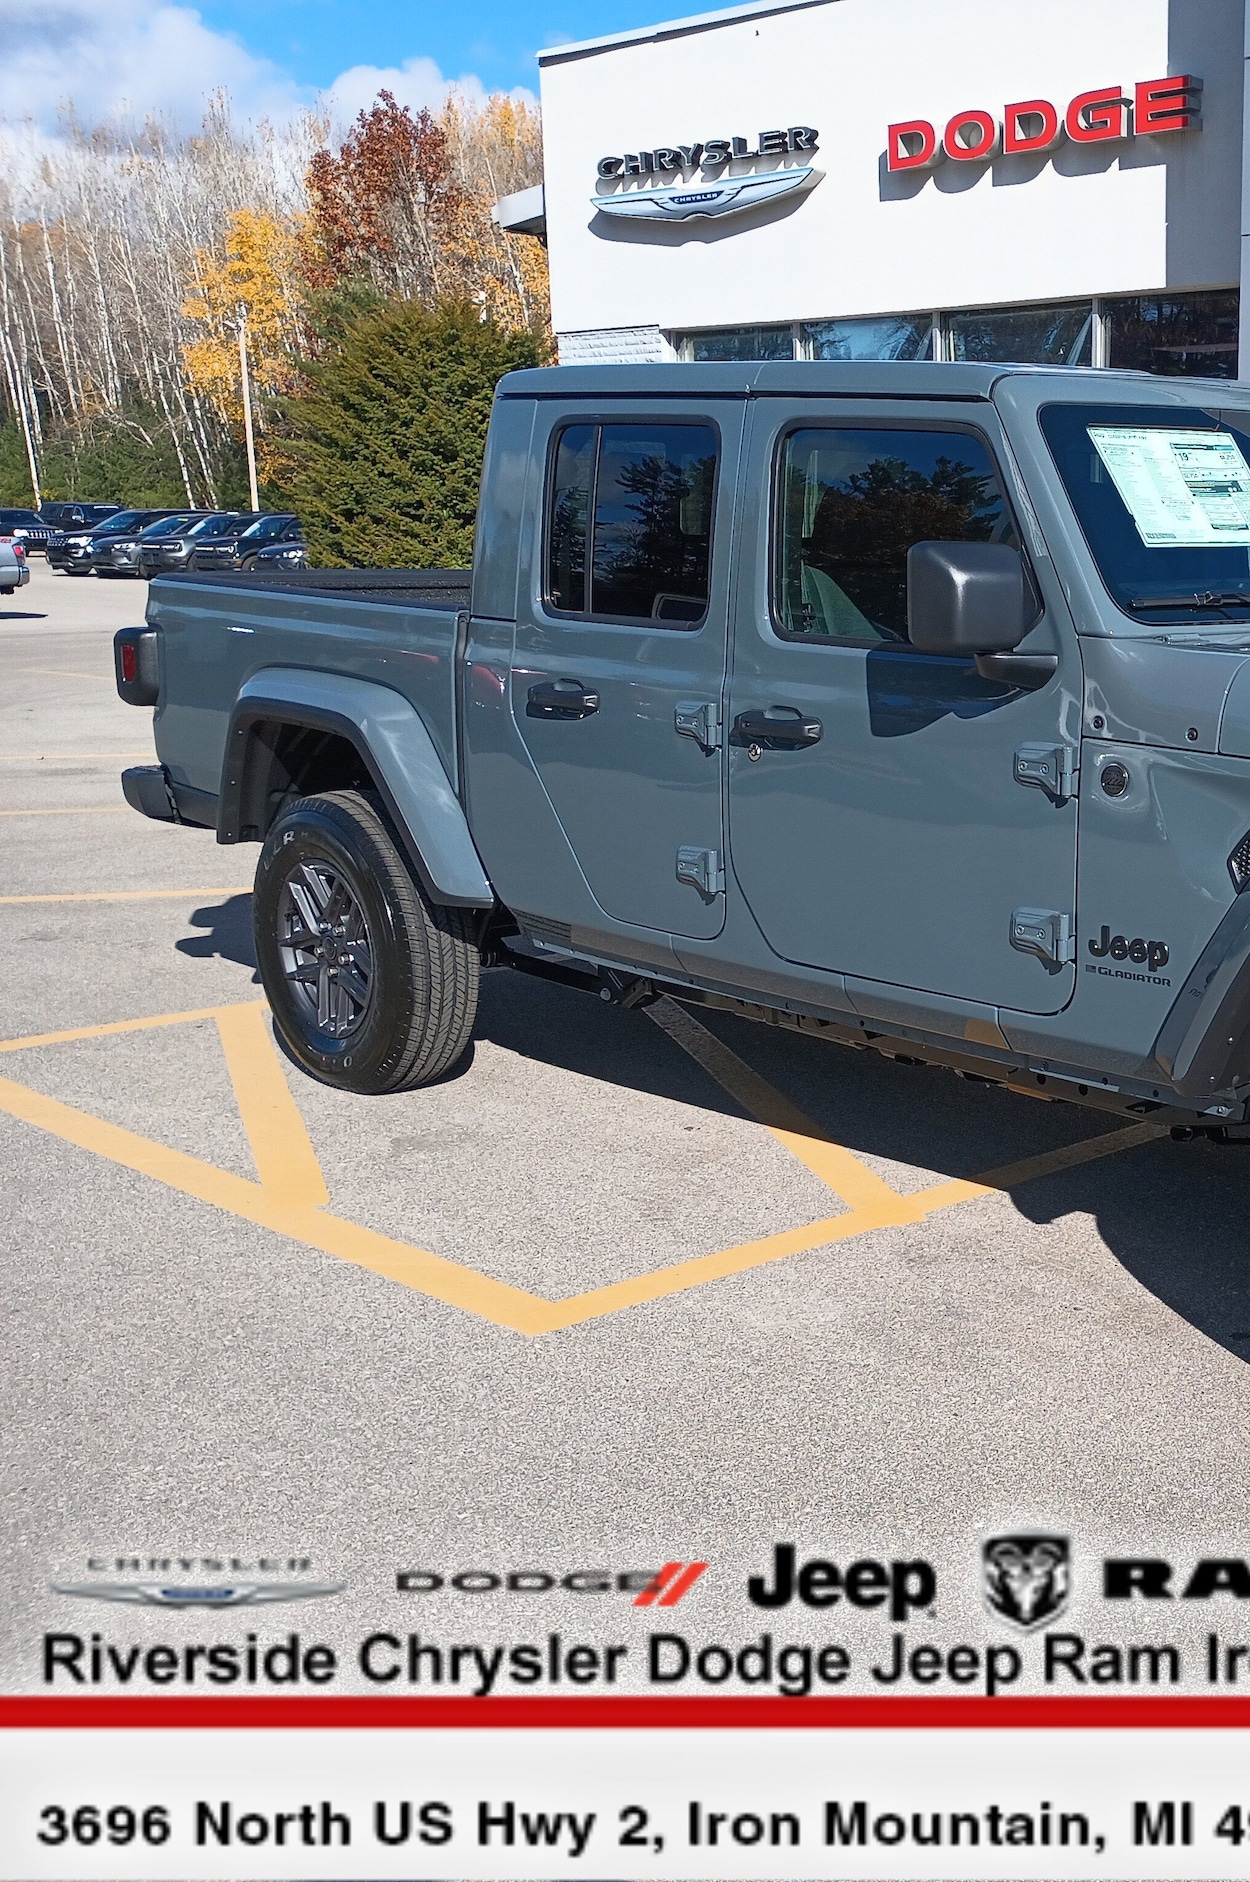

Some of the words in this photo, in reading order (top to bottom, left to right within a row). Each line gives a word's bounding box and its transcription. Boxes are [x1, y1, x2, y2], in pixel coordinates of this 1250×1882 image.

[886, 74, 1194, 172] DODGE
[597, 126, 819, 180] CHRYSLER
[673, 192, 719, 204] CHRYSLER
[1088, 924, 1170, 972] Jeep
[1097, 966, 1172, 987] GLADIATOR
